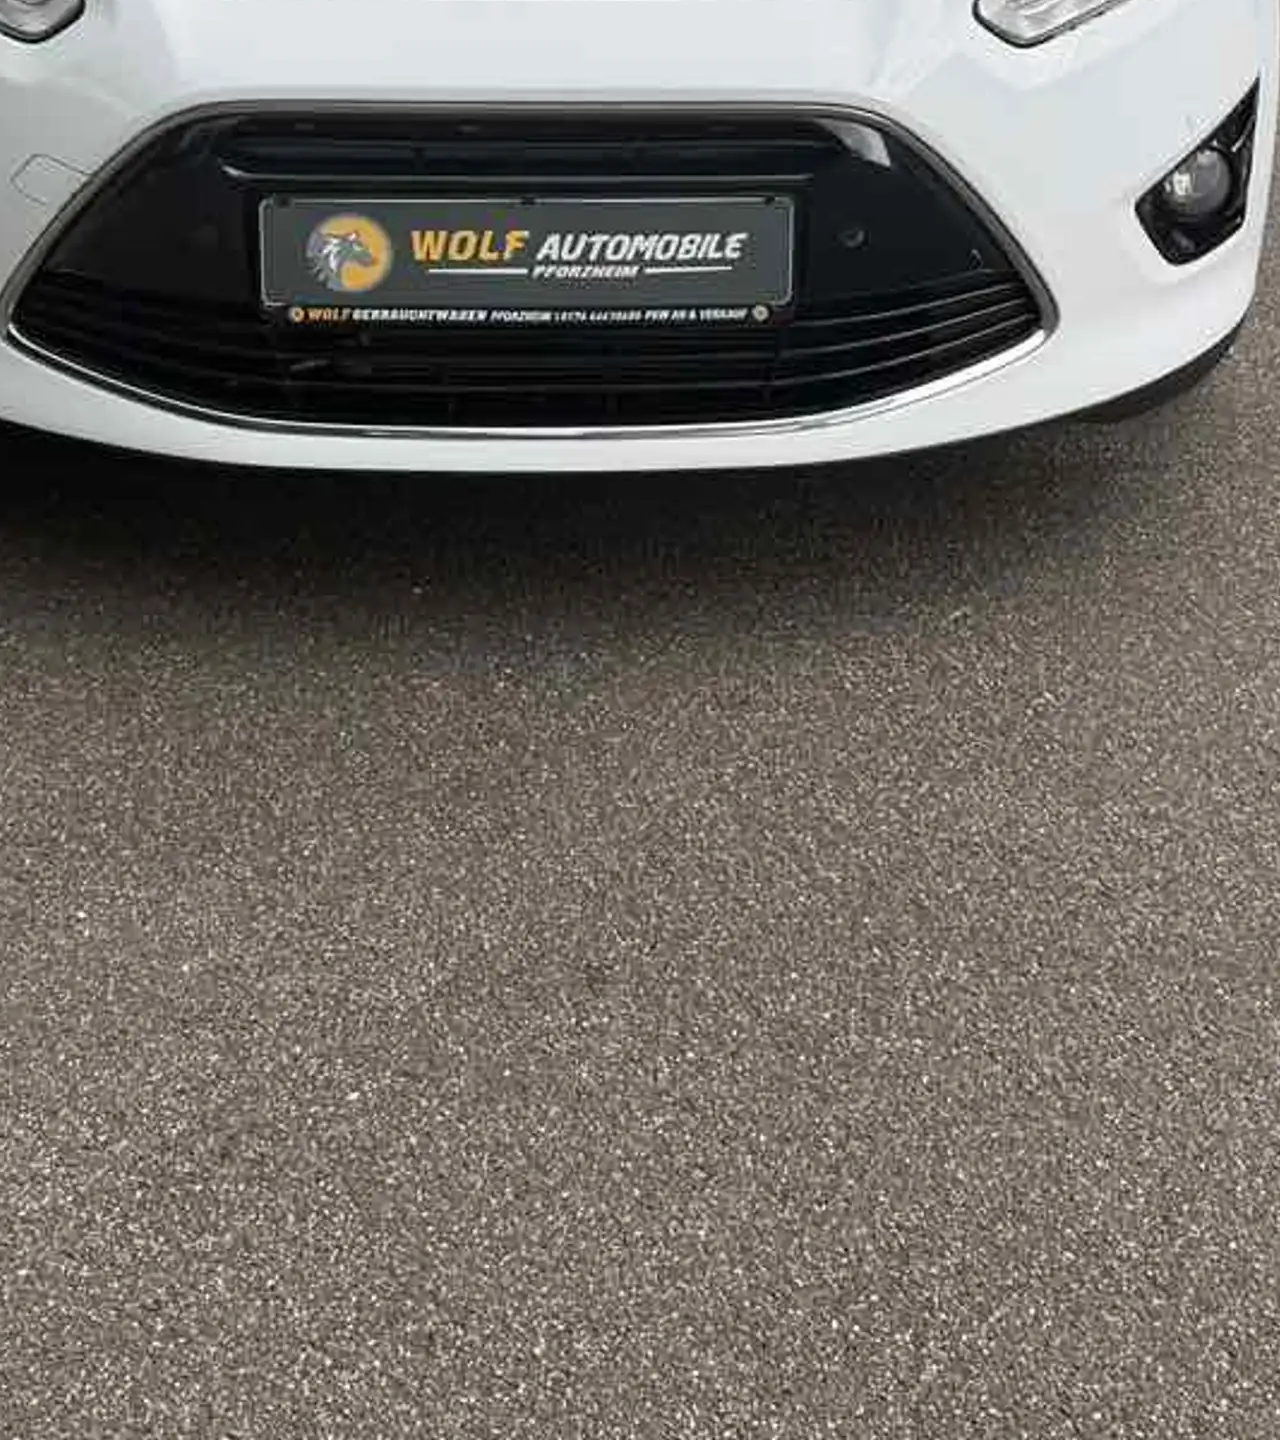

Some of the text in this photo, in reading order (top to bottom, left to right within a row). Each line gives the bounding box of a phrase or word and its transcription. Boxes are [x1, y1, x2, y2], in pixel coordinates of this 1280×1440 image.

[410, 230, 749, 261] WOLF AUTOMOBILE
[531, 264, 641, 279] PFORZHEIM
